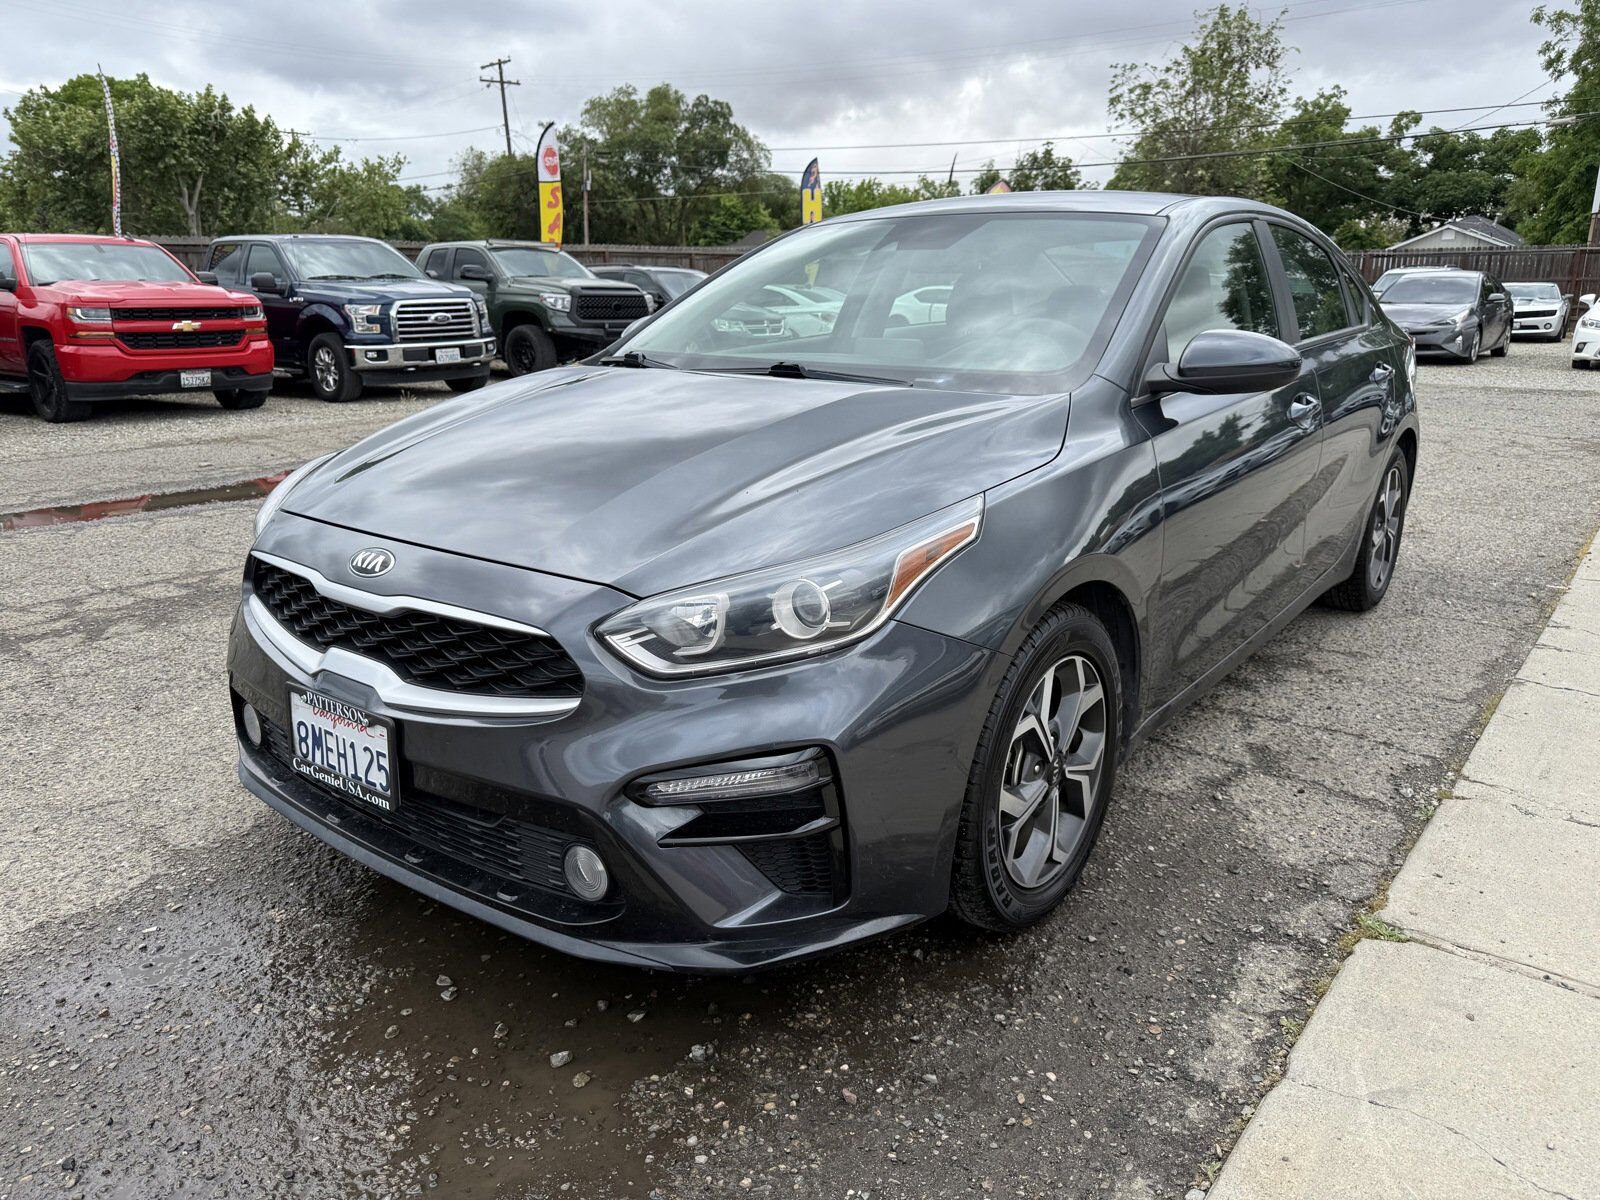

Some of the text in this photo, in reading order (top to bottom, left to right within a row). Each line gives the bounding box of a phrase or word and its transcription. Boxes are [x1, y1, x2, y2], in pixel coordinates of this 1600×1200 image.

[352, 551, 386, 572] KIA
[306, 691, 366, 724] PATTERSON
[297, 720, 391, 793] 8MEH125
[292, 757, 390, 810] CarGenieUSA.com
